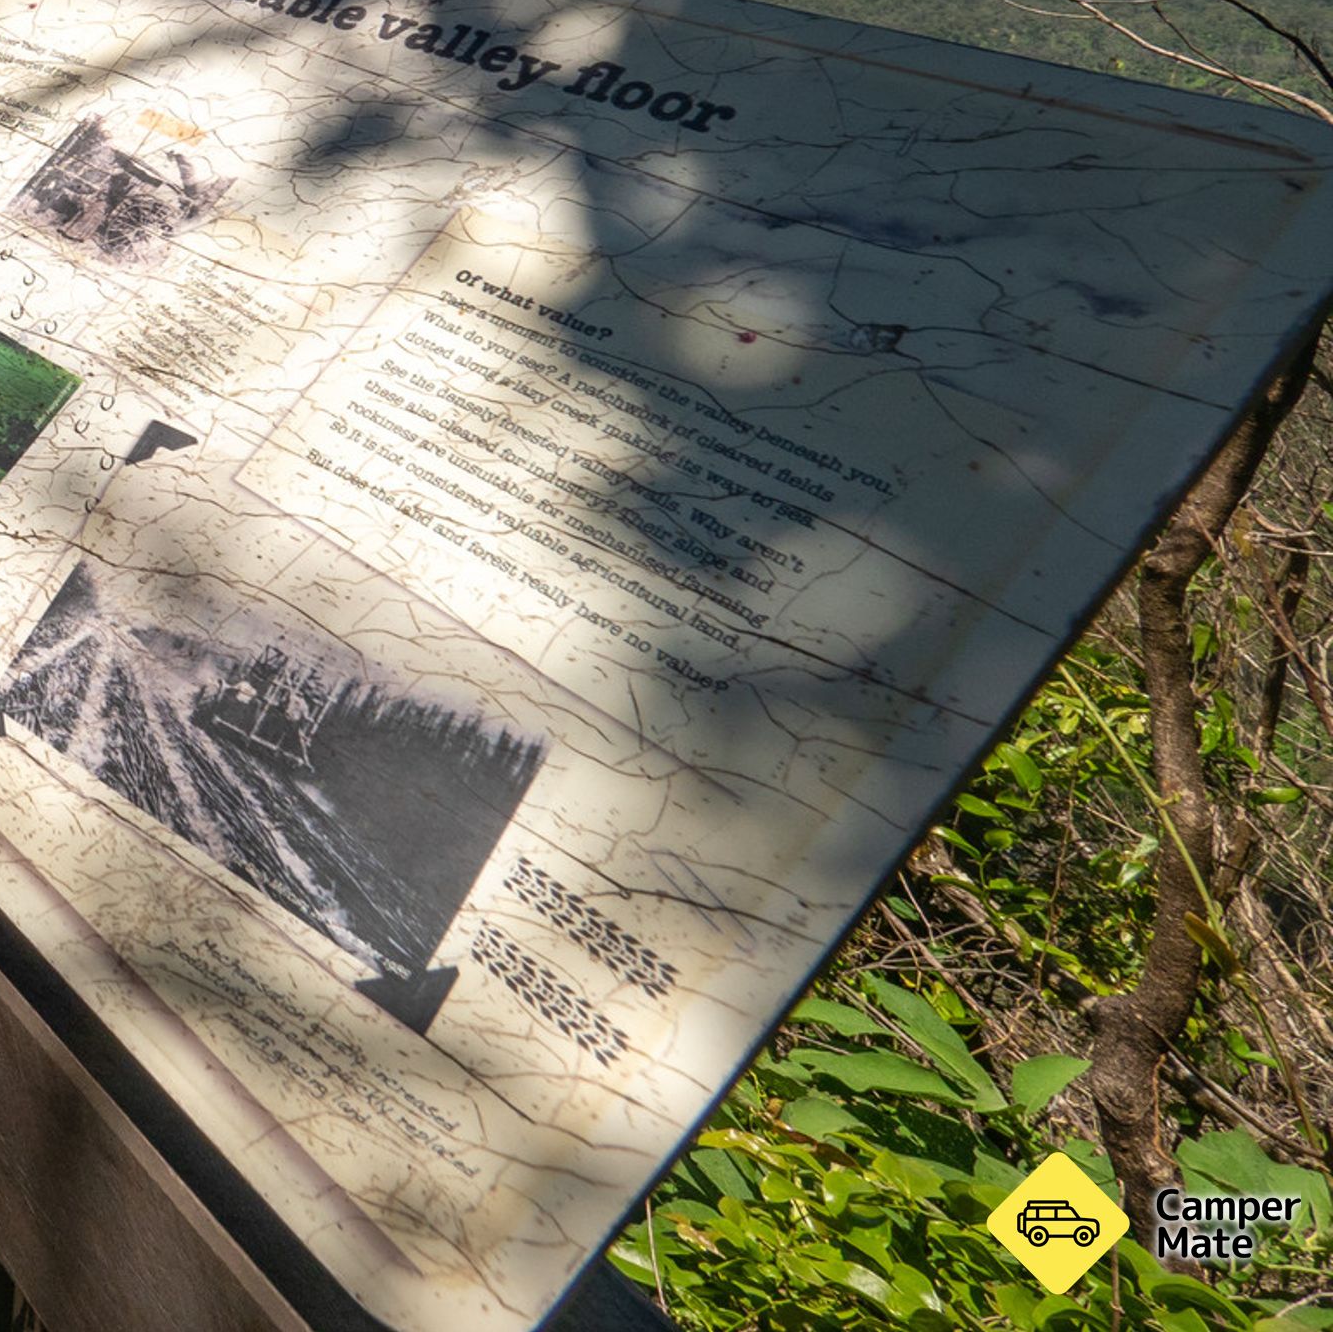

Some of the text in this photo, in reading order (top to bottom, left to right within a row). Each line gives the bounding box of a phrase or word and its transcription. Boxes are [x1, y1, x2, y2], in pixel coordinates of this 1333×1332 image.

[379, 13, 562, 93] valley
[562, 61, 737, 134] floor
[436, 289, 894, 496] Take a moment to consider the valley beneath you.
[452, 268, 615, 344] Of what value?
[363, 378, 775, 593] these also cleared for industry? Their slope and
[379, 358, 409, 379] See
[408, 372, 436, 393] the
[435, 385, 497, 425] densely
[497, 415, 570, 457] forested
[569, 452, 626, 489] valley
[627, 480, 680, 514] walls.
[686, 506, 733, 541] Why
[403, 329, 455, 360] dotted
[453, 355, 497, 383] along
[511, 379, 549, 407] lazy
[549, 398, 603, 428] creek
[601, 422, 675, 465] making
[675, 453, 703, 475] its
[704, 469, 749, 499] way
[749, 487, 774, 508] to
[775, 502, 816, 529] sea.
[420, 310, 834, 502] What do you see? A patchwork of cleared fields
[305, 447, 731, 695] But does the land and forest really have no value?
[329, 420, 348, 435] so
[361, 435, 377, 451] is
[376, 446, 407, 466] not
[404, 461, 496, 514] considered
[493, 509, 569, 556] valuable
[569, 550, 689, 620] agricultural
[687, 611, 739, 650] land.
[346, 400, 767, 629] rockiness are unsuitable for mechanised farming
[372, 1065, 460, 1132] increased
[396, 1112, 480, 1178] replaced
